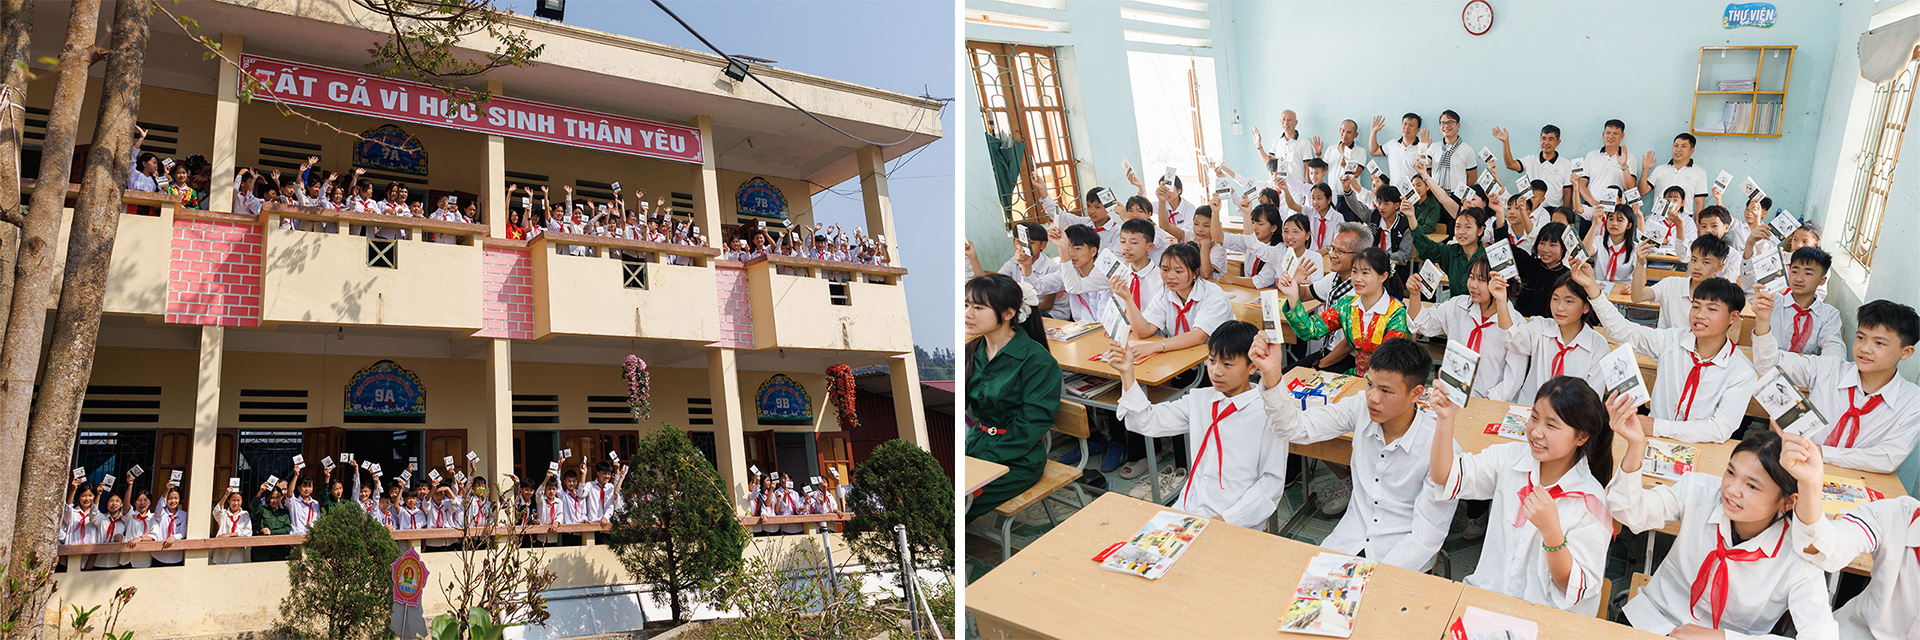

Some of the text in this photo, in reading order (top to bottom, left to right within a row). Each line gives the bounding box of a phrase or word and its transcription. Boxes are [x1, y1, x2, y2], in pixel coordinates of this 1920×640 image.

[256, 67, 686, 153] TẤT CẢ VÌ HỌC SINH THÂN YÊU
[381, 147, 400, 161] 7A
[755, 197, 768, 208] 7B
[375, 389, 395, 402] 9A
[776, 398, 790, 409] 9B
